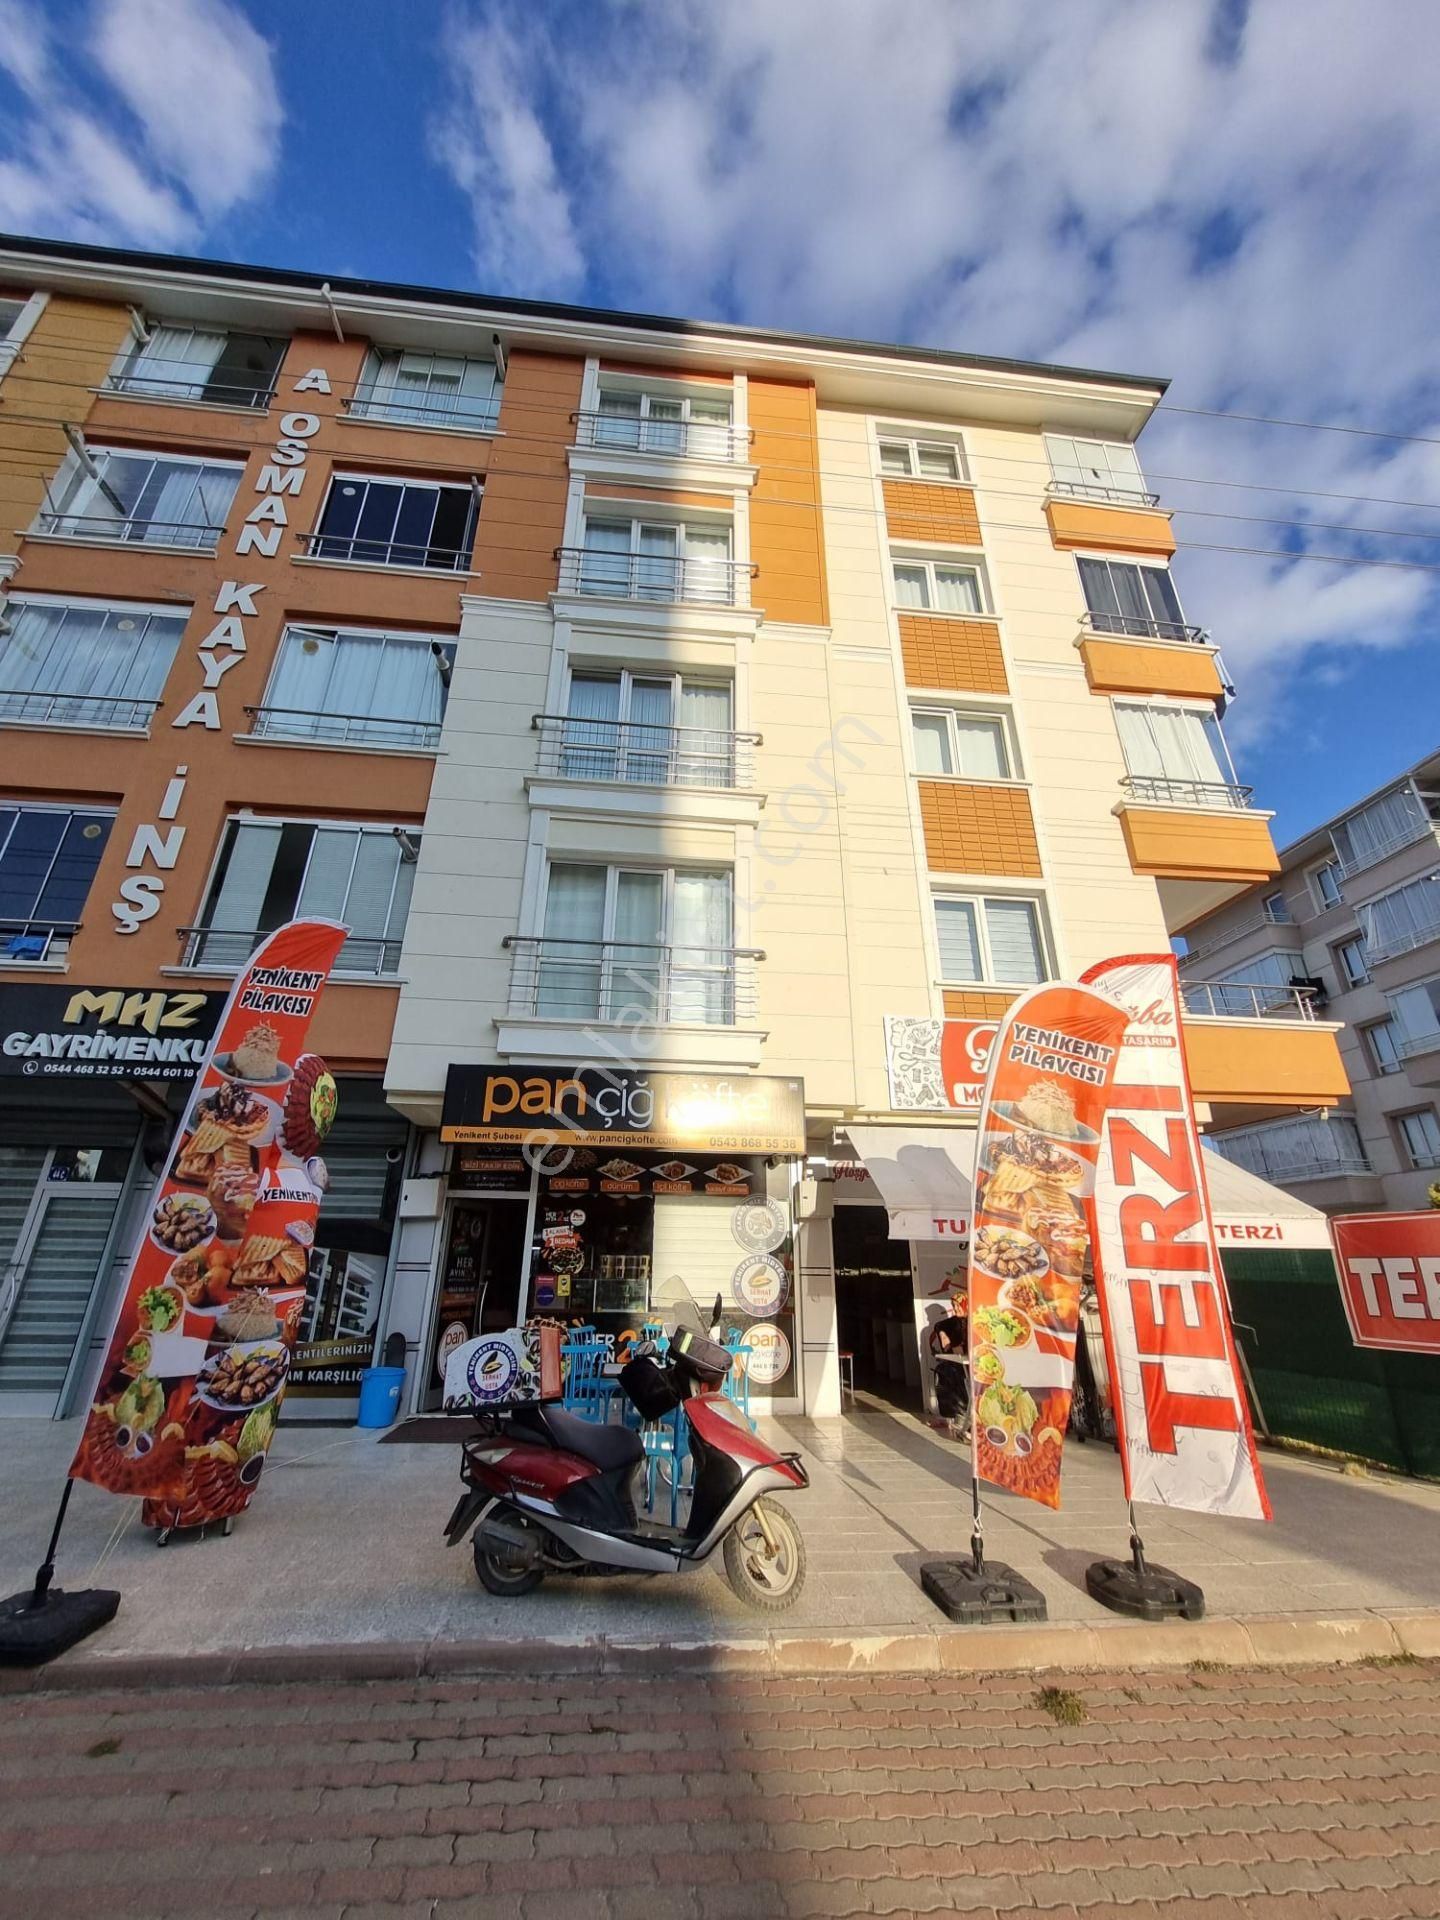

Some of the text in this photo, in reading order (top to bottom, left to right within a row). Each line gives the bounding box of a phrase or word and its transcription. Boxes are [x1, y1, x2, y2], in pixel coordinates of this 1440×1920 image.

[293, 368, 333, 395] A
[235, 413, 320, 558] OSMAN
[171, 580, 266, 730] KAYA
[111, 764, 188, 935] İNŞ
[249, 966, 324, 991] YENİKENT
[63, 989, 207, 1035] MHZ
[240, 987, 313, 1016] PİLAVCISI
[1014, 1023, 1113, 1063] YENİKENT
[1122, 1035, 1173, 1047] TASARIM
[44, 1064, 72, 1074] 0544
[74, 1065, 94, 1074] 468
[96, 1066, 109, 1075] 32
[111, 1066, 123, 1075] 52
[133, 1067, 160, 1076] 0544
[163, 1068, 181, 1077] 601
[184, 1068, 194, 1077] 18
[1010, 1045, 1105, 1085] PİLAVCISI
[482, 1076, 587, 1122] pan
[454, 1131, 490, 1139] Yenikent
[493, 1132, 522, 1141] Şubesi
[709, 1137, 737, 1147] 0543
[741, 1138, 762, 1148] 868
[766, 1138, 779, 1148] 55
[783, 1139, 796, 1149] 38
[1214, 1223, 1284, 1241] TERZİ
[750, 1334, 781, 1347] pan
